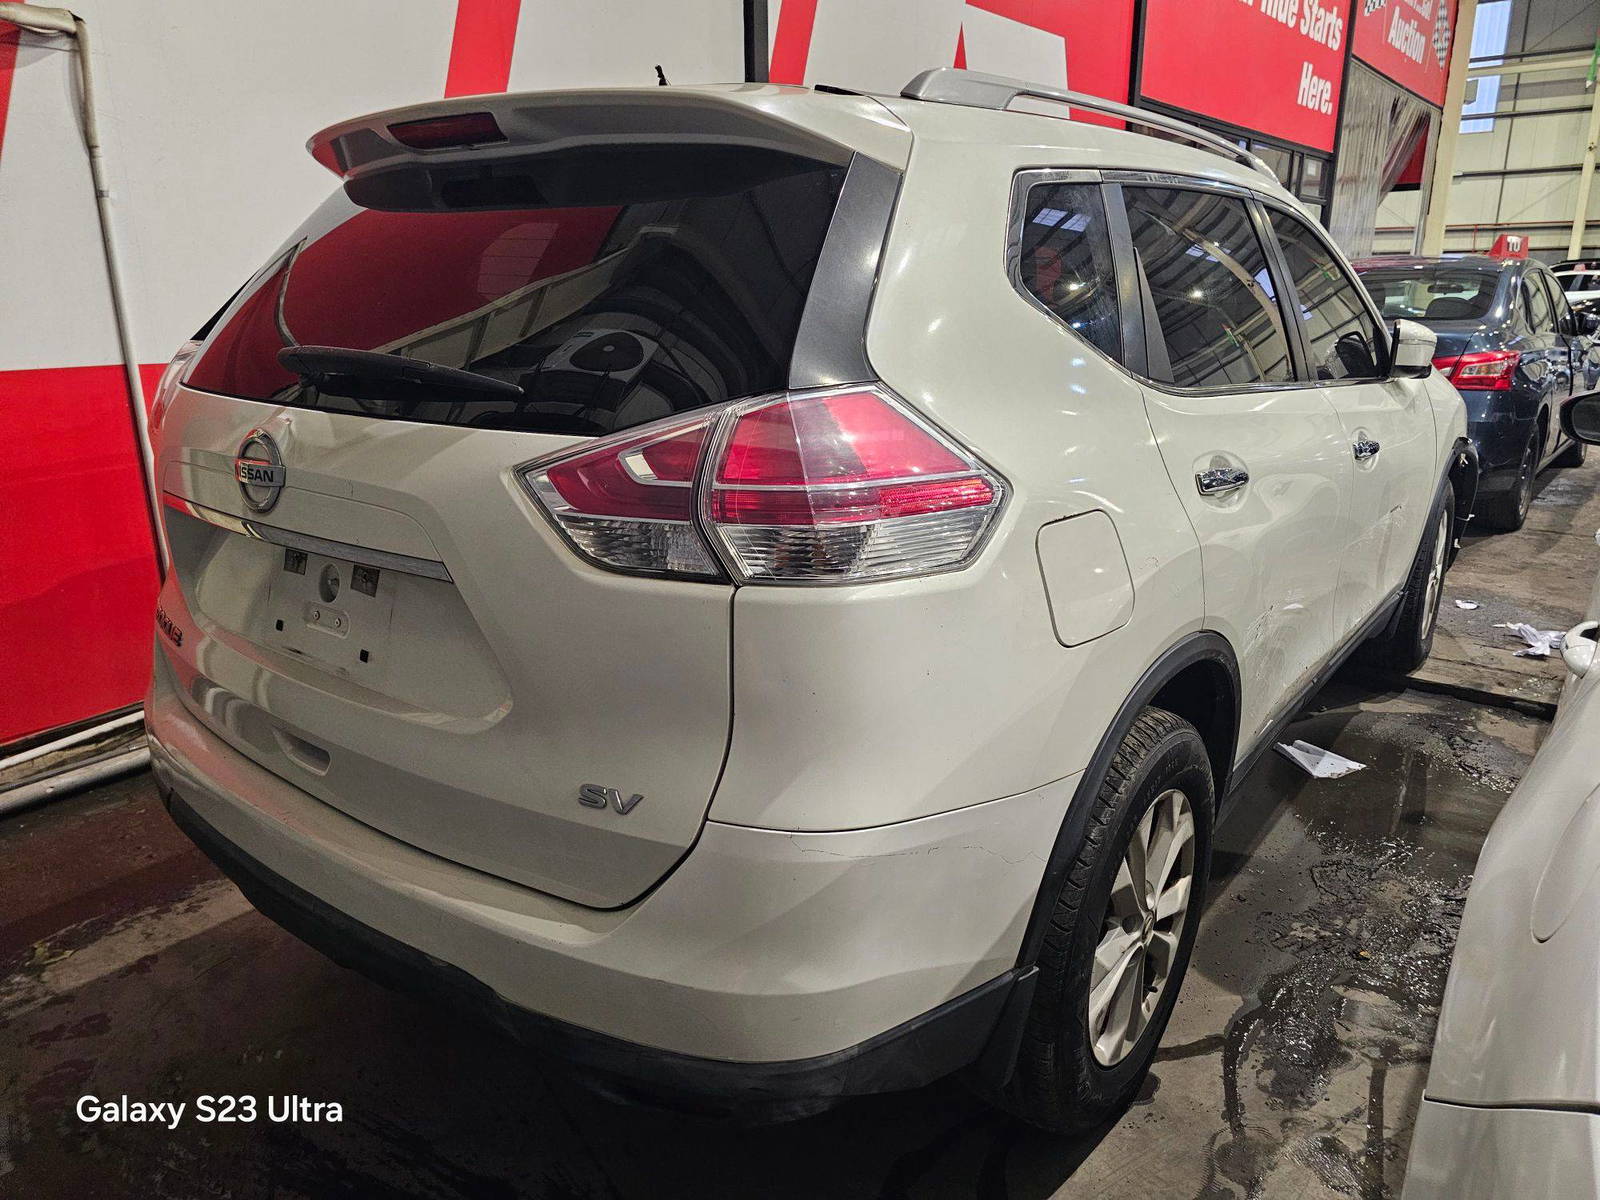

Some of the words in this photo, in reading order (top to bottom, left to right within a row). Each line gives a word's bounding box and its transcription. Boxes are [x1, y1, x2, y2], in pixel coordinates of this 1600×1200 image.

[1299, 0, 1343, 51] Starts
[1387, 5, 1426, 65] Auction
[1297, 61, 1333, 115] Here.
[578, 783, 644, 815] SV
